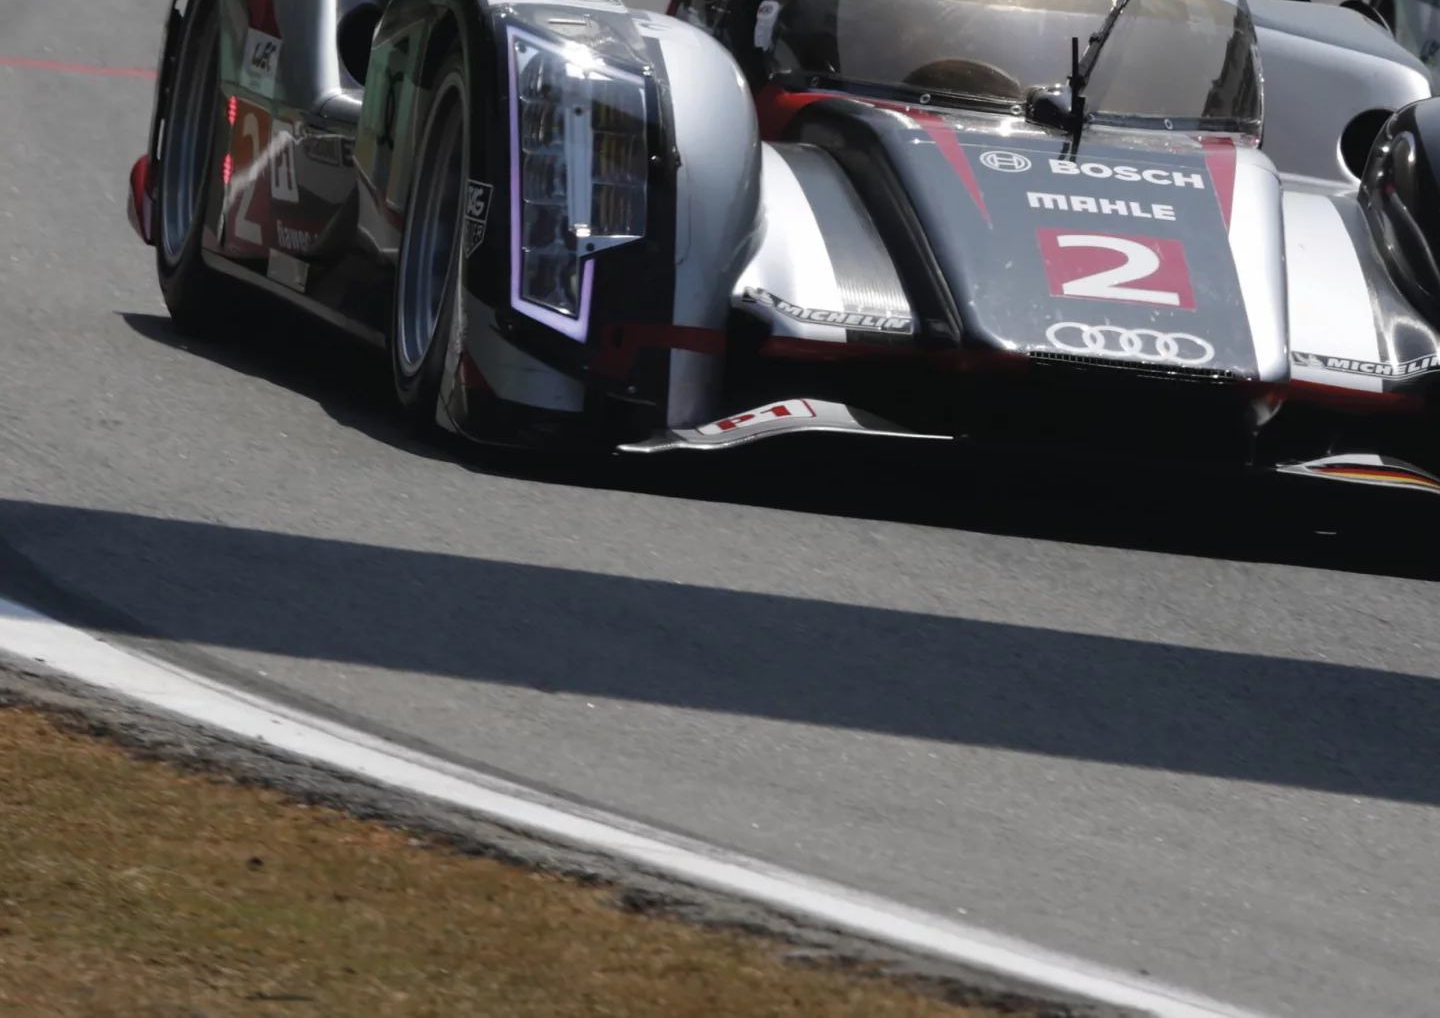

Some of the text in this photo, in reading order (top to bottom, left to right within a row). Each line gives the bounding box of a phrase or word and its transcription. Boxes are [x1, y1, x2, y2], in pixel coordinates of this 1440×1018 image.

[234, 112, 264, 246] 2
[1048, 158, 1205, 189] BOSCH
[1026, 191, 1177, 221] MAHLE
[1056, 234, 1181, 306] 2
[776, 299, 907, 329] MICHELIN
[716, 404, 793, 432] P1
